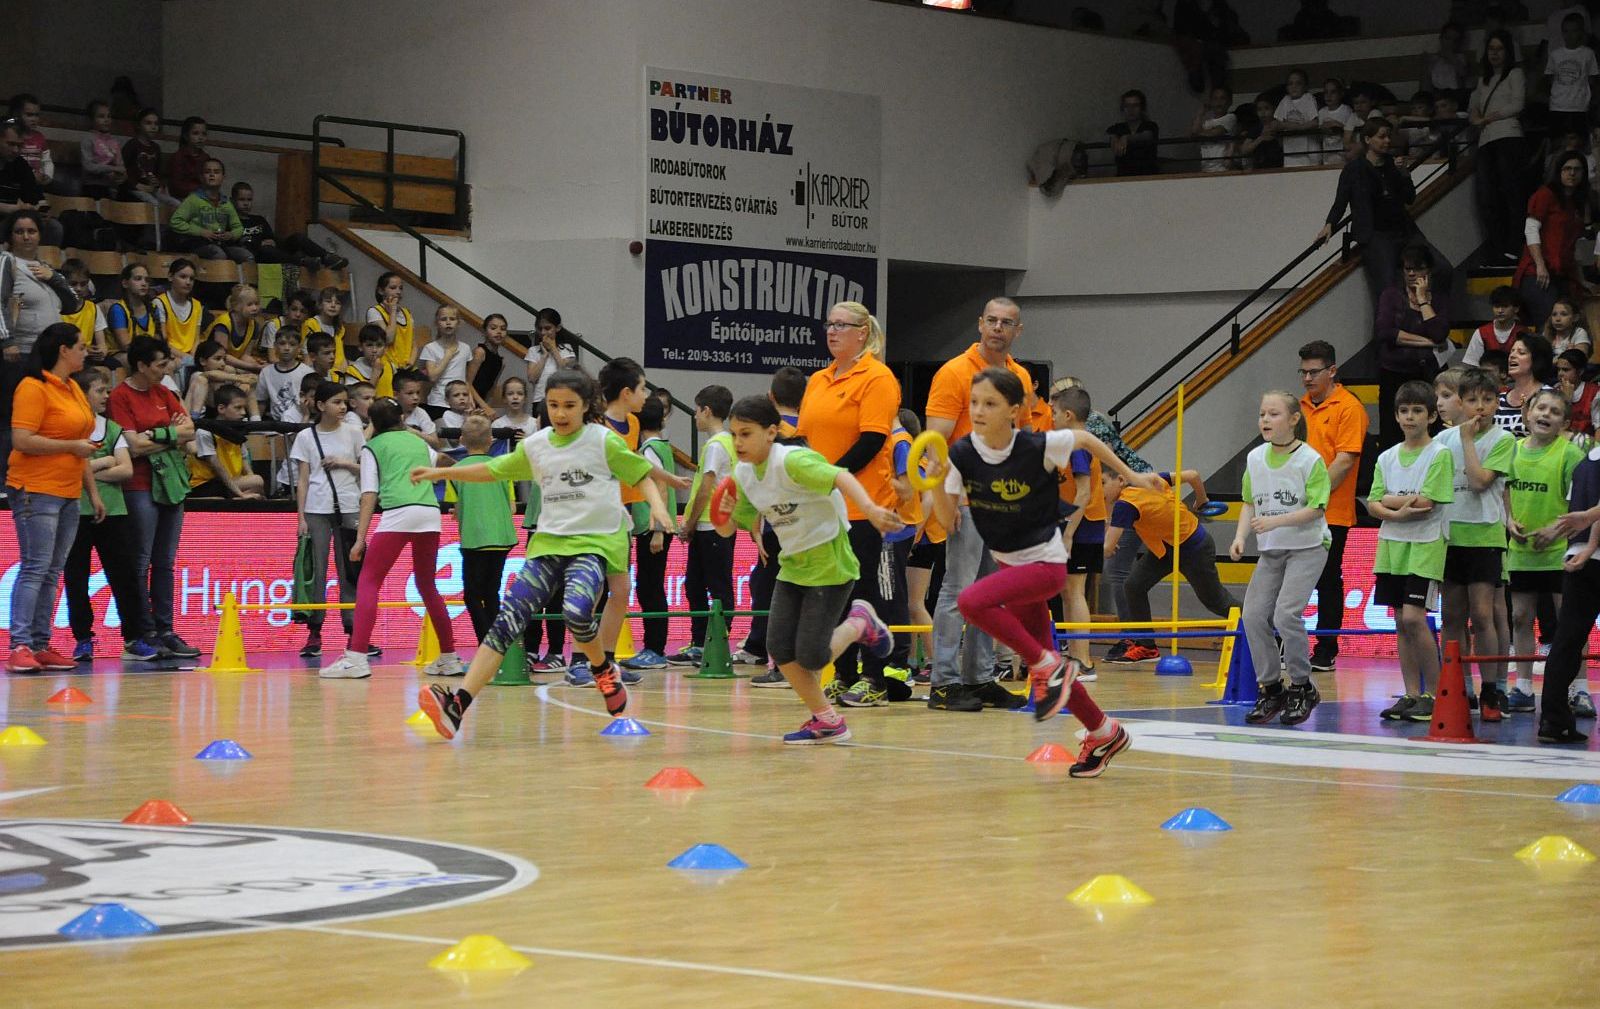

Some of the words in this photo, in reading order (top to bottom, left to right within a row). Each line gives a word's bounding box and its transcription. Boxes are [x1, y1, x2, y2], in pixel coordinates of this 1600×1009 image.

[650, 80, 732, 104] PARTNER
[650, 102, 794, 155] BÚTORHÁZ
[650, 157, 727, 180] IRODABÚTOROK
[811, 173, 870, 210] KARRIER
[734, 194, 778, 215] GYÁRTÁS
[649, 219, 733, 240] LAKBERENDEZÉS
[831, 211, 868, 229] BÚTOR
[785, 236, 877, 253] www.karrierirodabutor.hu
[711, 316, 785, 345] Építőipari
[789, 326, 816, 344] Kft.
[662, 347, 685, 360] Tel.:
[687, 349, 753, 364] 20/9-336-113
